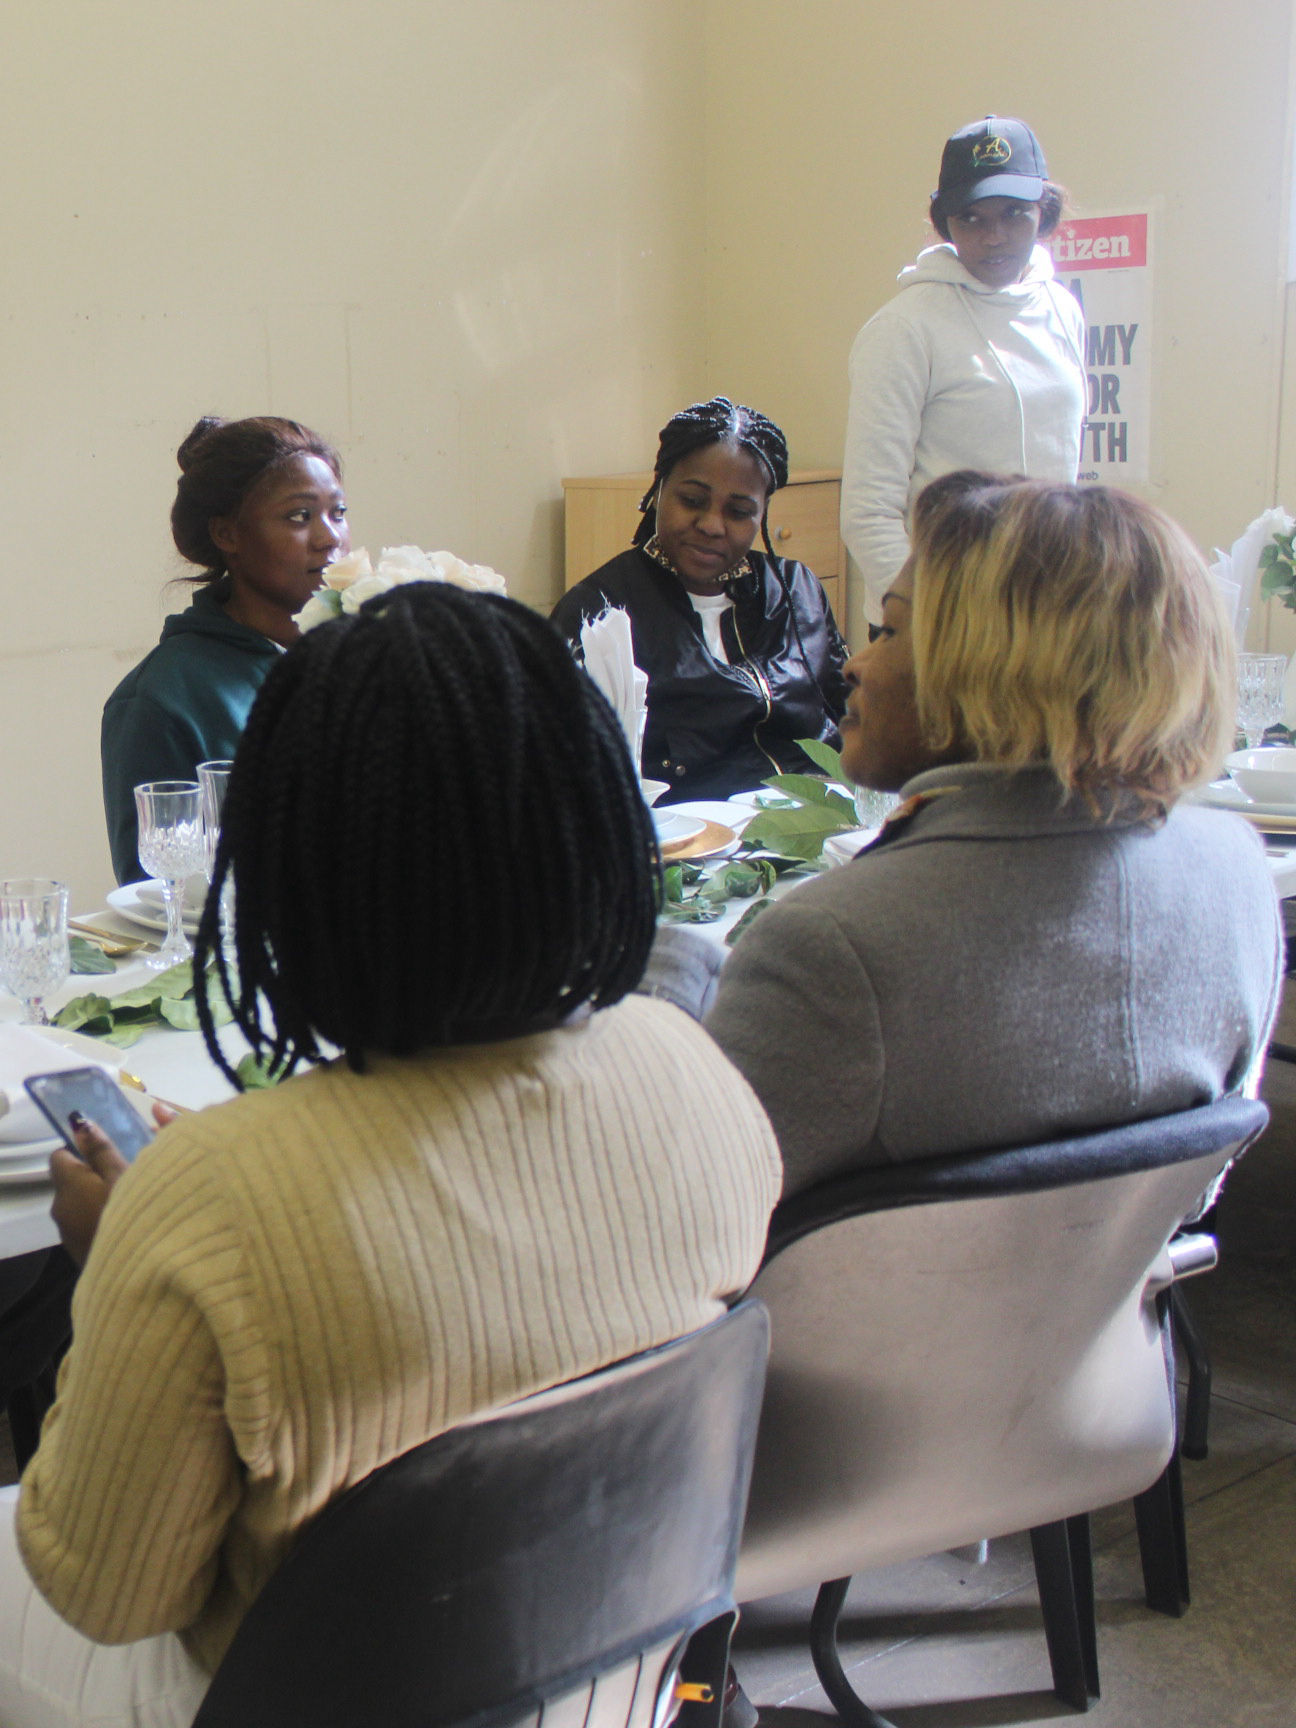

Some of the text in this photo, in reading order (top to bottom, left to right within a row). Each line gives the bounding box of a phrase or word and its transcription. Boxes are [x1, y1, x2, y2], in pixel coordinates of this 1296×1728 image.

[1084, 323, 1138, 366] MY
[1086, 373, 1121, 415] OR
[1080, 421, 1128, 463] TH
[1078, 470, 1099, 480] web
